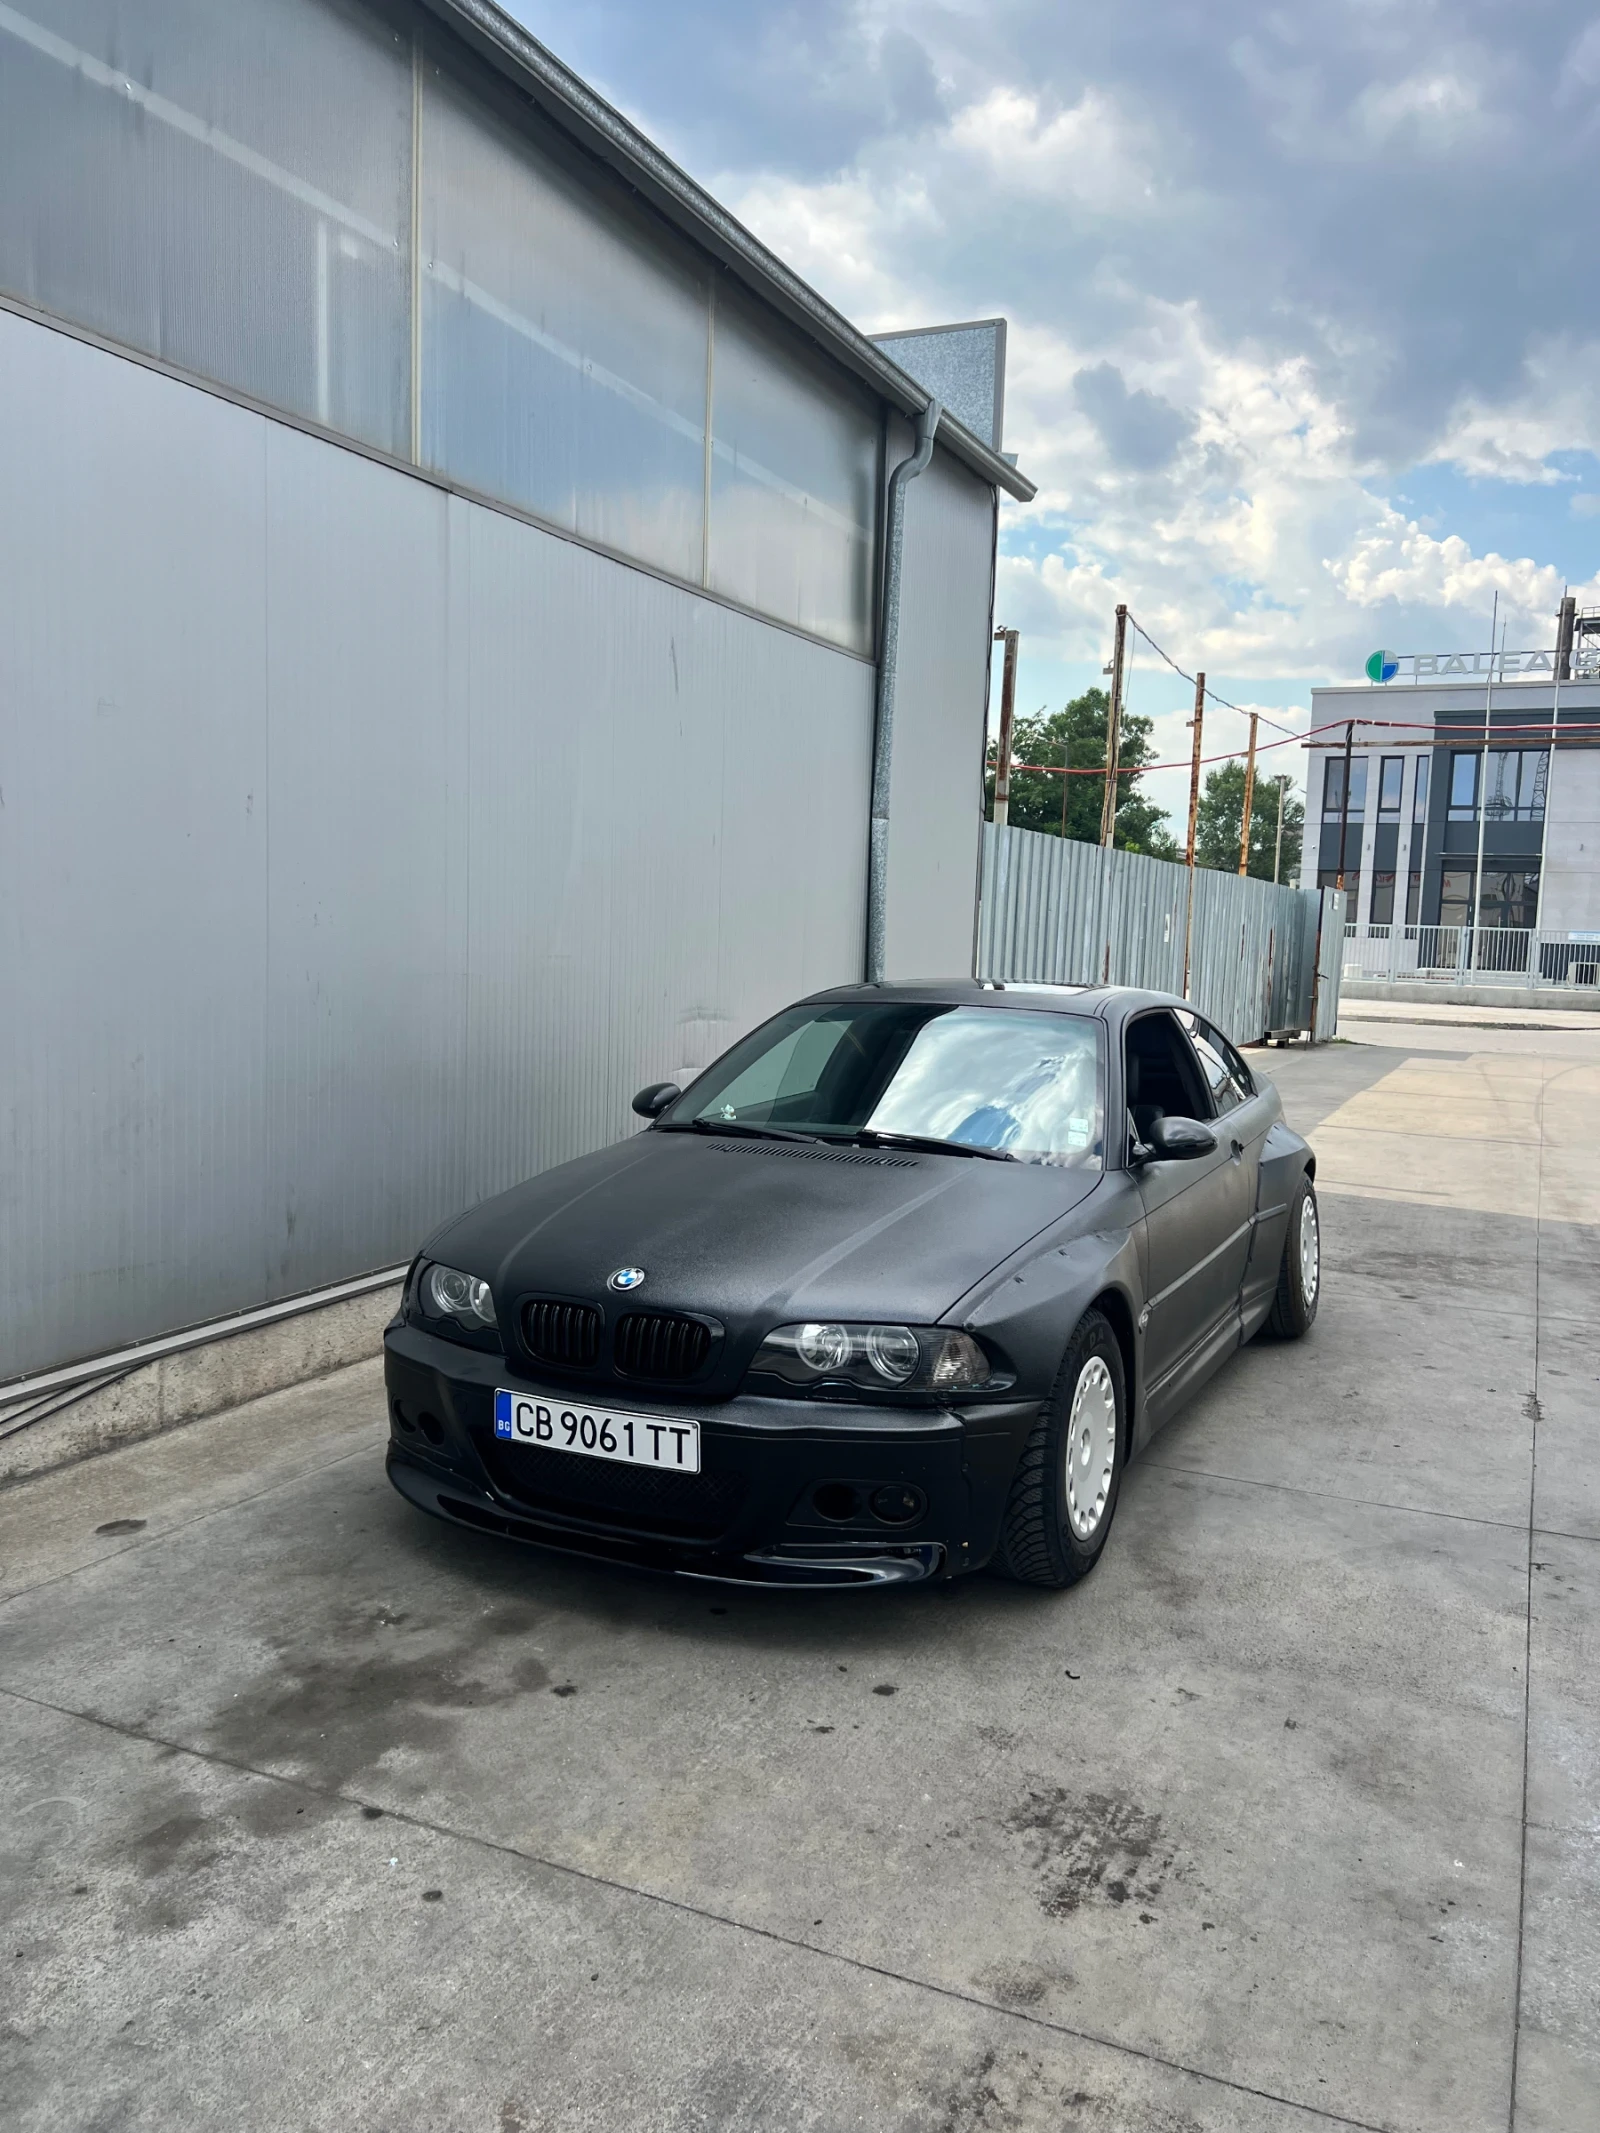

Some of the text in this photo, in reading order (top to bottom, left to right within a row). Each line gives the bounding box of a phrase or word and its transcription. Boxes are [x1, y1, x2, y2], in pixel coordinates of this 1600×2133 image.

[1413, 650, 1553, 676] BALEA
[498, 1420, 511, 1432] BG
[516, 1401, 691, 1464] CB 9061 TT
